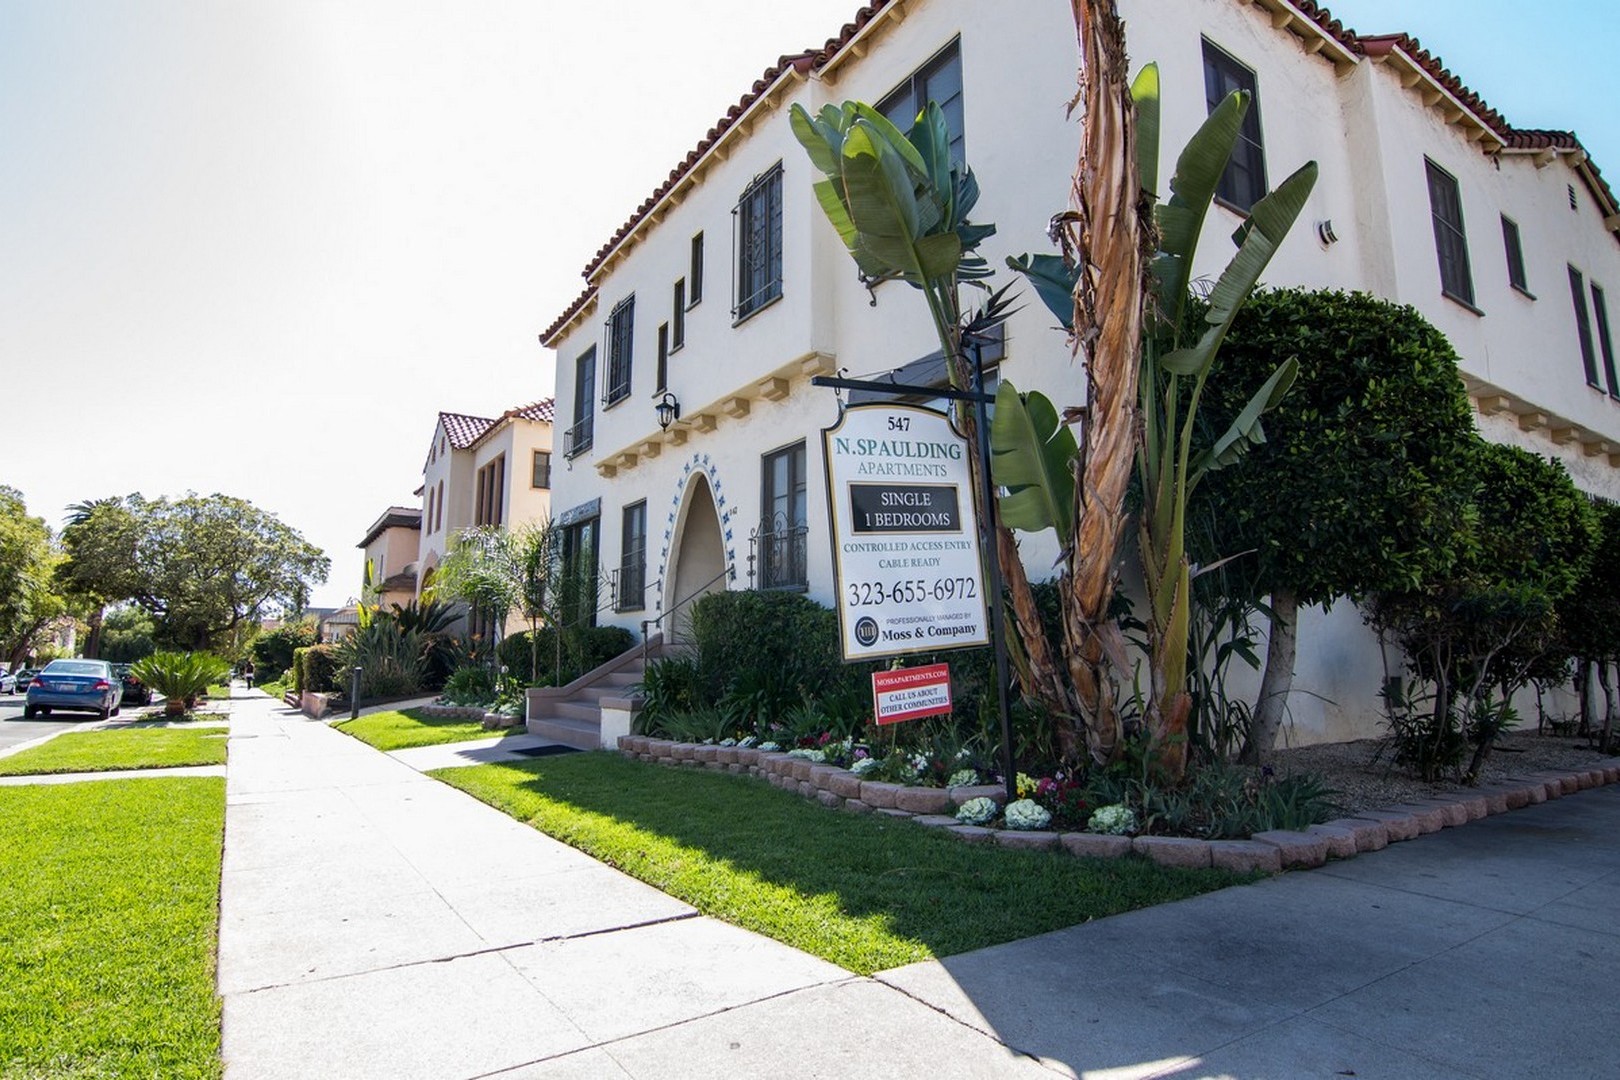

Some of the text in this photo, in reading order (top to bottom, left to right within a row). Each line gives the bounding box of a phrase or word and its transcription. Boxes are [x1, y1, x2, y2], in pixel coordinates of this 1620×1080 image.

[888, 415, 911, 432] 547
[836, 437, 961, 460] N.SPAULDING
[858, 462, 947, 477] APARTMENTS
[881, 492, 932, 507] SINGLE
[865, 513, 951, 527] 1 BEDROOMS
[844, 540, 972, 553] CONTROLLED ACCESS ENTRY
[878, 557, 941, 569] CABLE READY
[849, 577, 976, 607] 323-655-6972
[886, 615, 936, 625] PROFESSIONALLY
[936, 612, 963, 621] MANAGED
[882, 629, 912, 641] Moss
[914, 626, 925, 639] &
[927, 624, 977, 637] Company
[889, 688, 938, 703] CALL US ABOUT
[881, 703, 903, 714] OTHER
